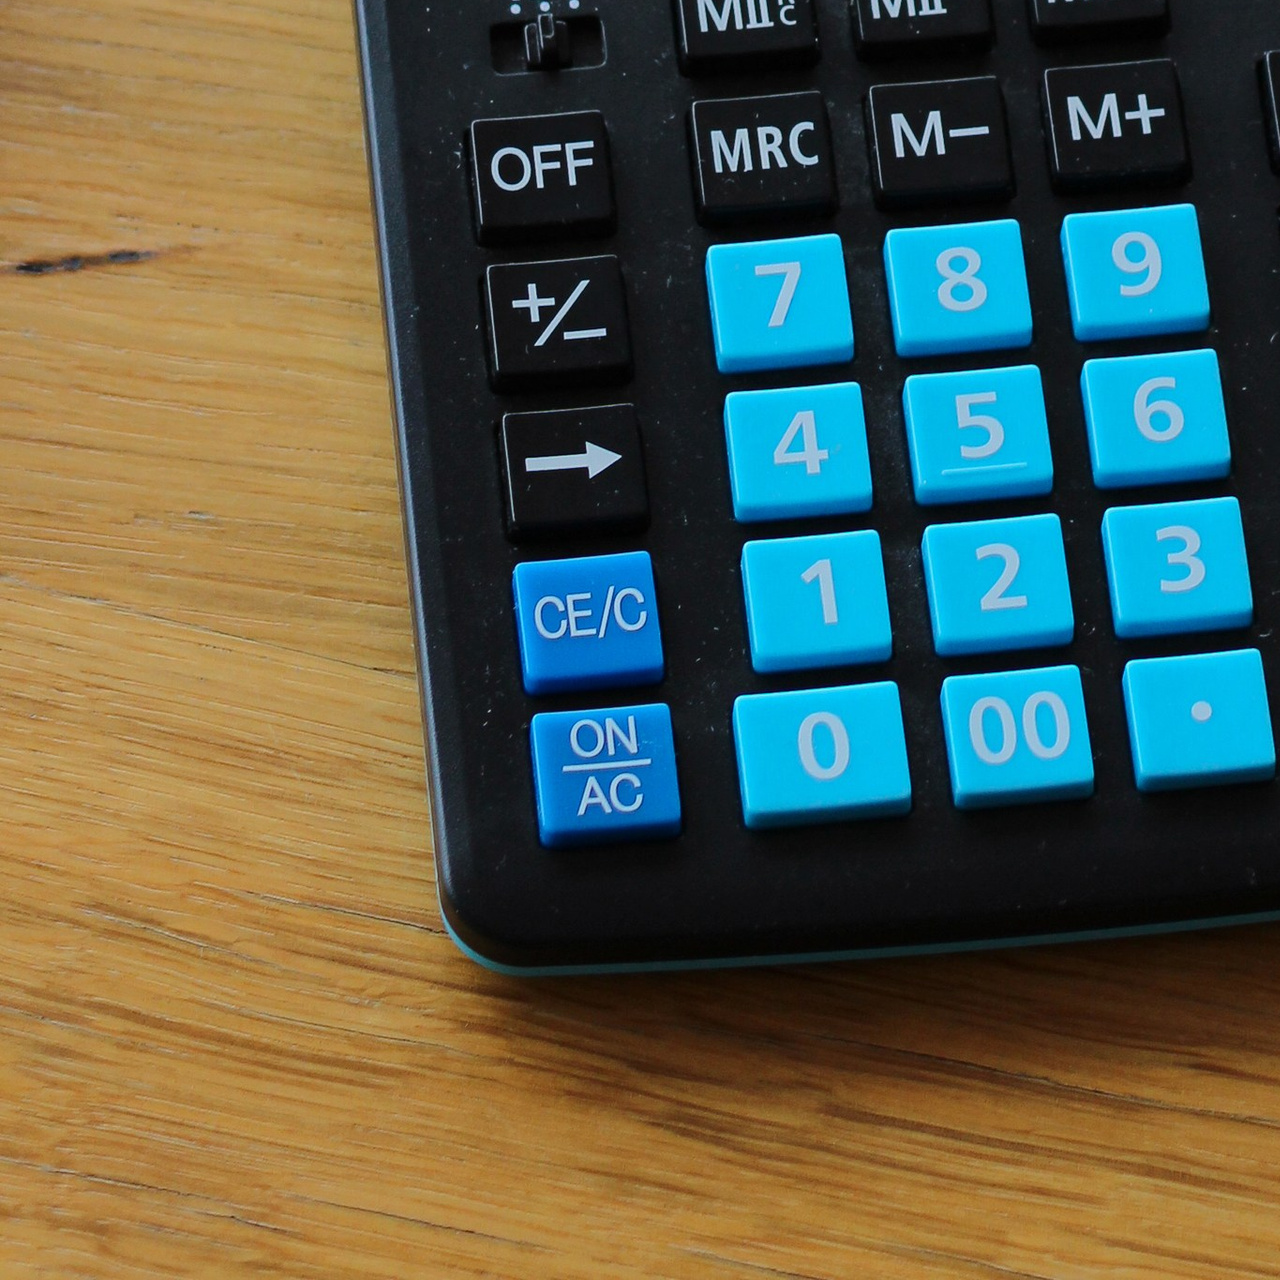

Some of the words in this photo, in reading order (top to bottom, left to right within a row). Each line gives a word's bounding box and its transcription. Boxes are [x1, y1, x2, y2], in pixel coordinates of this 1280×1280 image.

[710, 121, 819, 174] MRC
[1066, 92, 1166, 141] M+
[490, 140, 595, 192] OFF
[754, 261, 802, 328] 7
[935, 246, 988, 313] 8
[1111, 231, 1162, 297] 9
[773, 410, 829, 475] 4
[955, 391, 1005, 459] 5
[1133, 376, 1185, 443] 6
[800, 559, 838, 625] 1
[975, 543, 1028, 611] 2
[1155, 525, 1206, 593] 3
[534, 585, 647, 639] CE/C
[568, 714, 639, 759] ON
[797, 711, 850, 781] 0
[968, 690, 1071, 766] 00
[576, 771, 644, 817] AC
